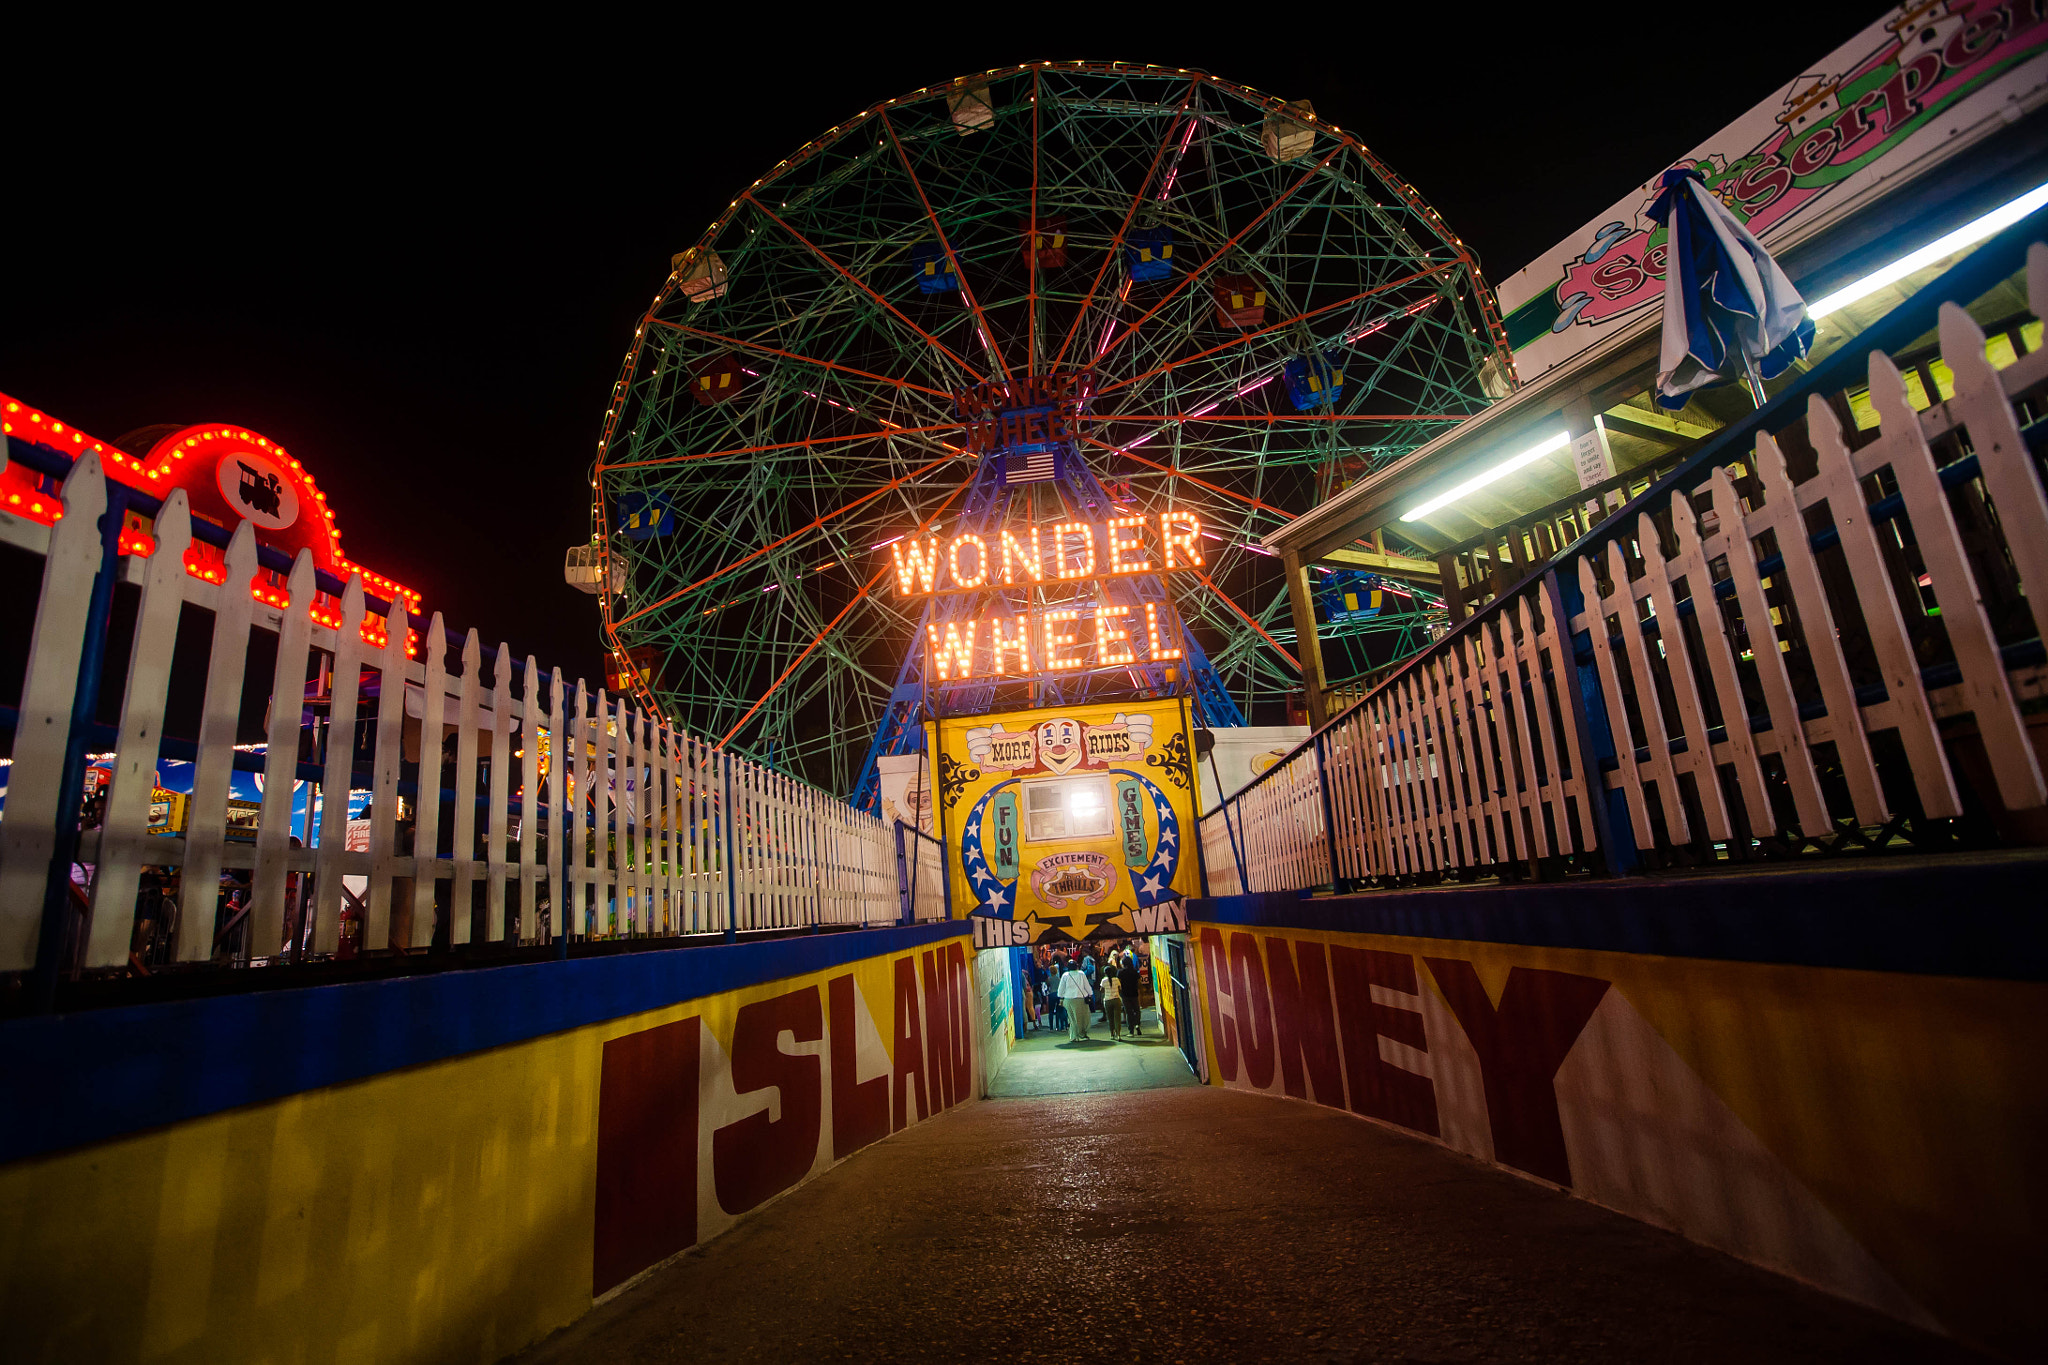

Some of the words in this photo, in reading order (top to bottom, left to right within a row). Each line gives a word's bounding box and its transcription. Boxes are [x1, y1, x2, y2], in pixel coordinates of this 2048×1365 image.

[1592, 242, 1668, 300] Se
[954, 369, 1098, 416] WONDER
[967, 408, 1093, 450] WHEEL
[891, 510, 1206, 596] WONDER
[926, 602, 1182, 681] WHEEL
[991, 740, 1032, 762] MORE
[1088, 732, 1131, 755] RIDES
[999, 806, 1013, 867] FUN
[1122, 787, 1142, 857] GAMES
[1042, 854, 1105, 869] EXCITEMENT
[1052, 879, 1096, 895] THRILLS
[971, 915, 1030, 948] THIS
[1132, 897, 1188, 933] WAY
[1200, 928, 1613, 1189] CONEY
[593, 941, 973, 1299] ISLAND
